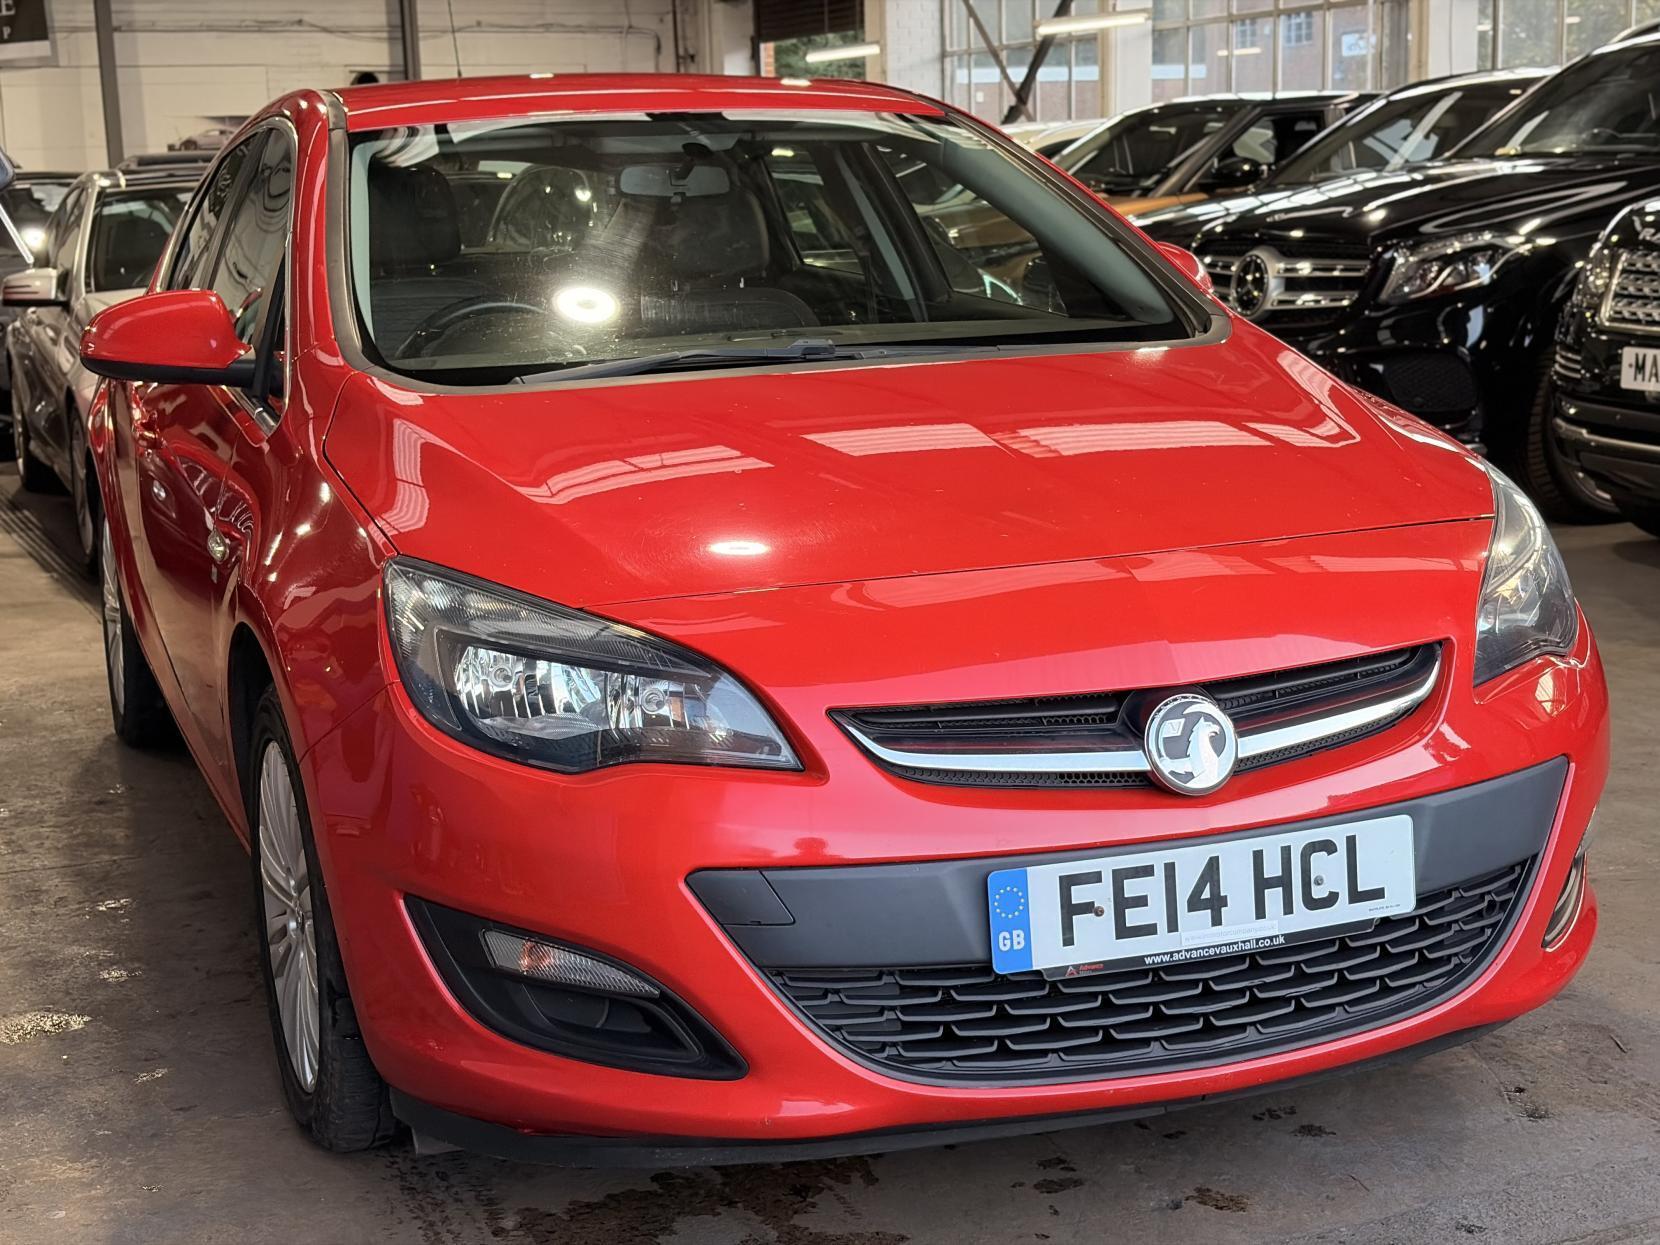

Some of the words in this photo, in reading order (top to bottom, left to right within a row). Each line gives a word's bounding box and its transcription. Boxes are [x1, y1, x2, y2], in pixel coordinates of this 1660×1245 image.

[1058, 856, 1229, 947] FE14
[1252, 834, 1386, 921] HCL
[998, 929, 1026, 952] GB
[1144, 935, 1286, 965] www.advancevauxhall.co.uk
